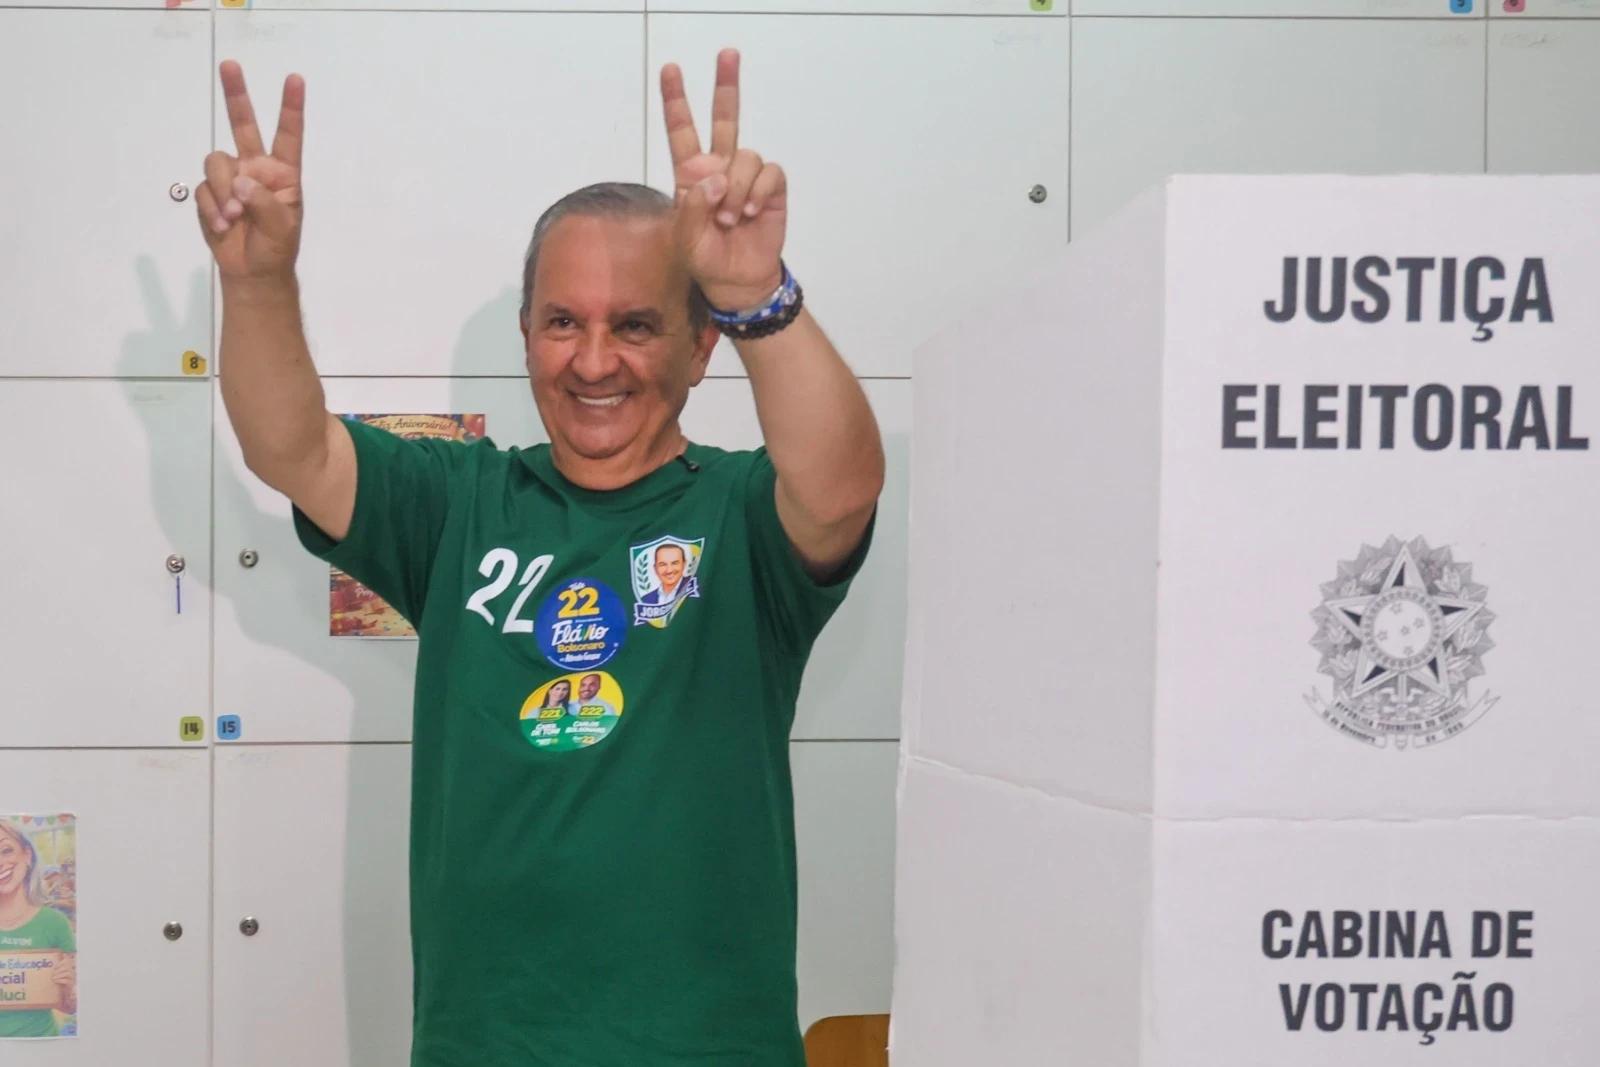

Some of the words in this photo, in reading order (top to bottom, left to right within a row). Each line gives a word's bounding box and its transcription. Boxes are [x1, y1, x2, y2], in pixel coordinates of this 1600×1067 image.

[1263, 255, 1554, 342] JUSTIÇA
[190, 356, 199, 369] 8
[1221, 383, 1590, 451] ELEITORAL
[465, 547, 554, 634] 22
[558, 586, 600, 619] 22
[184, 722, 199, 735] 14
[222, 720, 236, 734] 15
[1261, 909, 1452, 960] CABINA
[1471, 910, 1534, 959] DE
[0, 971, 25, 985] cial
[8, 957, 54, 971] Educação
[1279, 971, 1515, 1046] VOTAÇÃO
